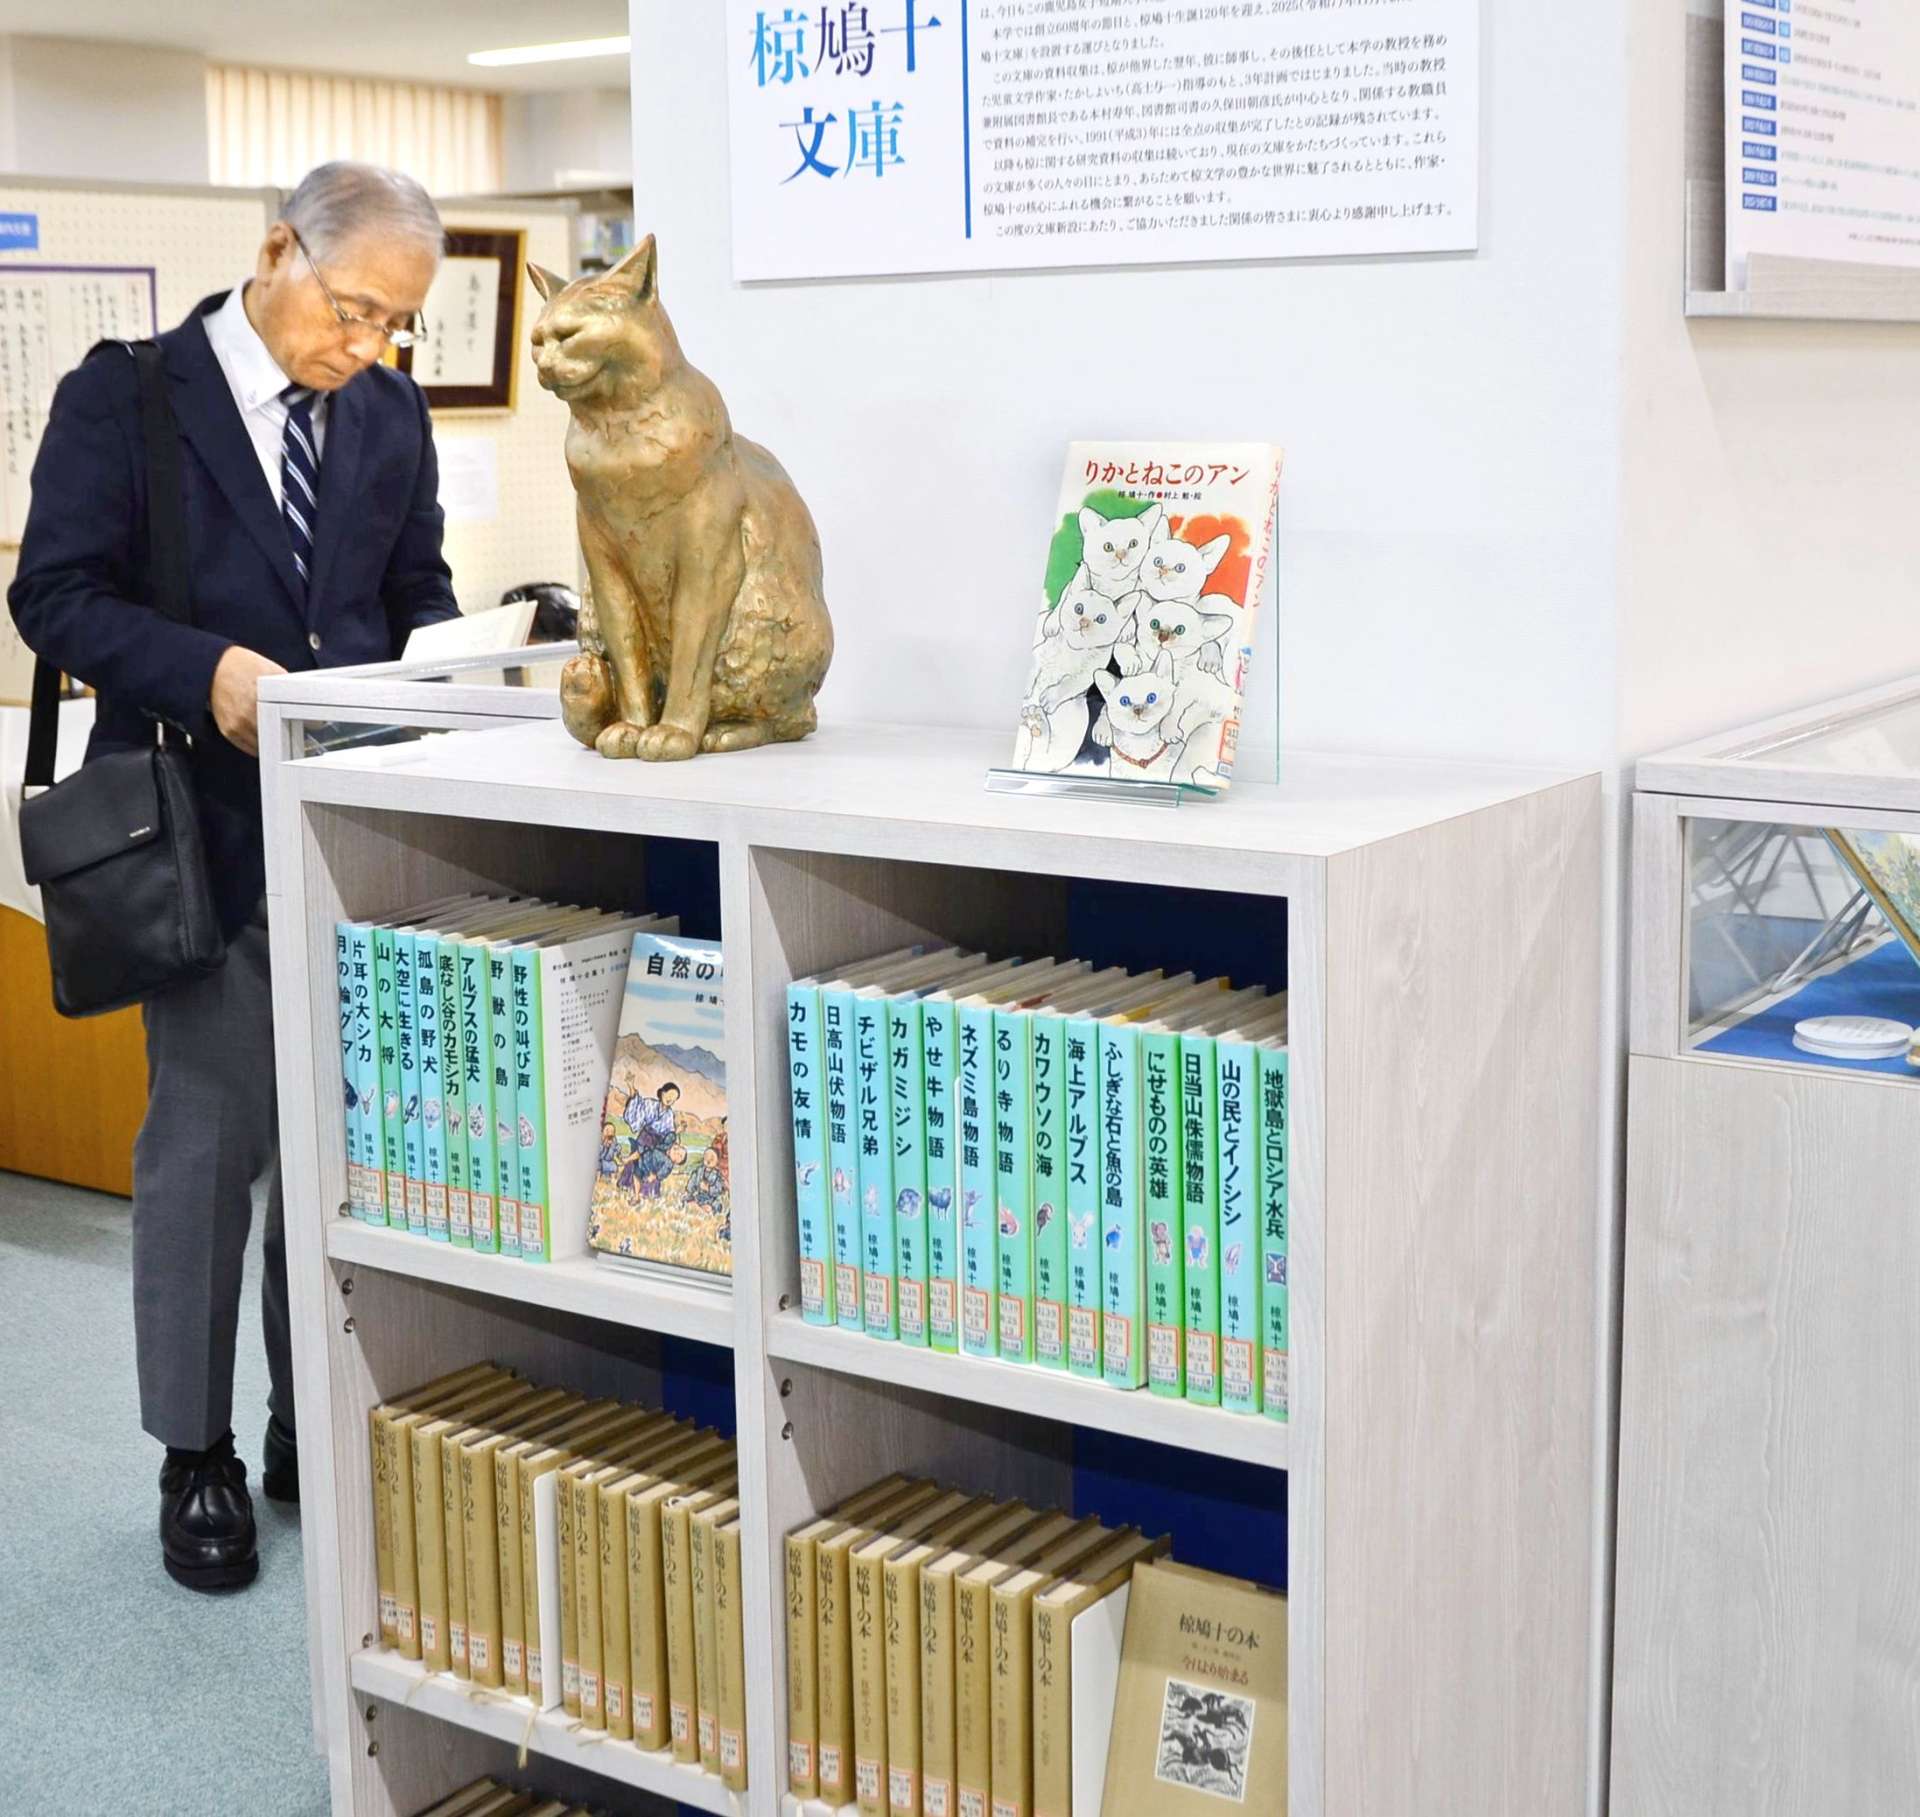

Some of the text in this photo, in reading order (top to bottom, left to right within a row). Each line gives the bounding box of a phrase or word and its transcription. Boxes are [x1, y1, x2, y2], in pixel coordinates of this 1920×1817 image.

[749, 0, 942, 87] 椋鳩十
[778, 100, 906, 186] 文庫
[1085, 460, 1250, 485] りかとねこのアン
[647, 952, 723, 981] 自然の
[353, 941, 371, 1063] 片耳の大シカ
[377, 943, 395, 1065] 山の大将
[395, 947, 414, 1070] 大空に生きる
[418, 950, 438, 1074] 孤島の野犬
[461, 957, 480, 1083] アルプスの猛犬
[490, 960, 508, 1087] 野獣の島
[439, 955, 459, 1096] 底なし谷のカモシカ
[514, 965, 530, 1091] 野性の叫び声
[789, 1002, 812, 1139] カモの友情
[827, 1006, 846, 1144] 日高山伏物語
[858, 1016, 879, 1156] チビザル兄弟
[892, 1017, 912, 1157] カガミジシ
[926, 1016, 944, 1159] やせ牛物語
[961, 1024, 979, 1168] ネズミ島物語
[996, 1030, 1014, 1174] るり寺物語
[1035, 1033, 1053, 1177] カワウソの海
[1067, 1037, 1087, 1185] 海上アルプス
[347, 1127, 356, 1163] 椋鳩十
[1105, 1041, 1123, 1208] ふしぎな石と魚の島
[1147, 1051, 1169, 1199] にせものの英雄
[1184, 1053, 1205, 1205] 日当山侏儒物語
[1221, 1059, 1242, 1226] 山の民とイノシシ
[364, 1133, 374, 1168] 椋鳩十
[387, 1137, 397, 1173] 椋鳩十
[406, 1142, 416, 1180] 椋鳩十
[429, 1147, 439, 1184] 椋鳩十
[450, 1153, 460, 1189] 椋鳩十
[1264, 1068, 1285, 1240] 地獄島とロシア水兵
[472, 1157, 482, 1193] 椋鳩十
[500, 1161, 509, 1198] 椋鳩十
[521, 1166, 531, 1205] 椋鳩十
[802, 1218, 813, 1259] 椋鳩十
[837, 1224, 847, 1264] 椋鳩十
[868, 1233, 879, 1274] 椋鳩十
[901, 1237, 912, 1280] 椋鳩十
[932, 1237, 943, 1279] 椋鳩十
[967, 1247, 977, 1289] 椋鳩十
[1002, 1253, 1012, 1296] 椋鳩十
[1039, 1258, 1050, 1300] 椋鳩十
[1074, 1266, 1085, 1307] 椋鳩十
[1109, 1271, 1120, 1315] 椋鳩十
[1155, 1282, 1166, 1325] 椋鳩十
[1190, 1286, 1202, 1331] 椋鳩十
[1227, 1295, 1239, 1338] 椋鳩十
[1270, 1305, 1282, 1350] 椋鳩十
[1180, 1612, 1260, 1650] 椋鳩十の本
